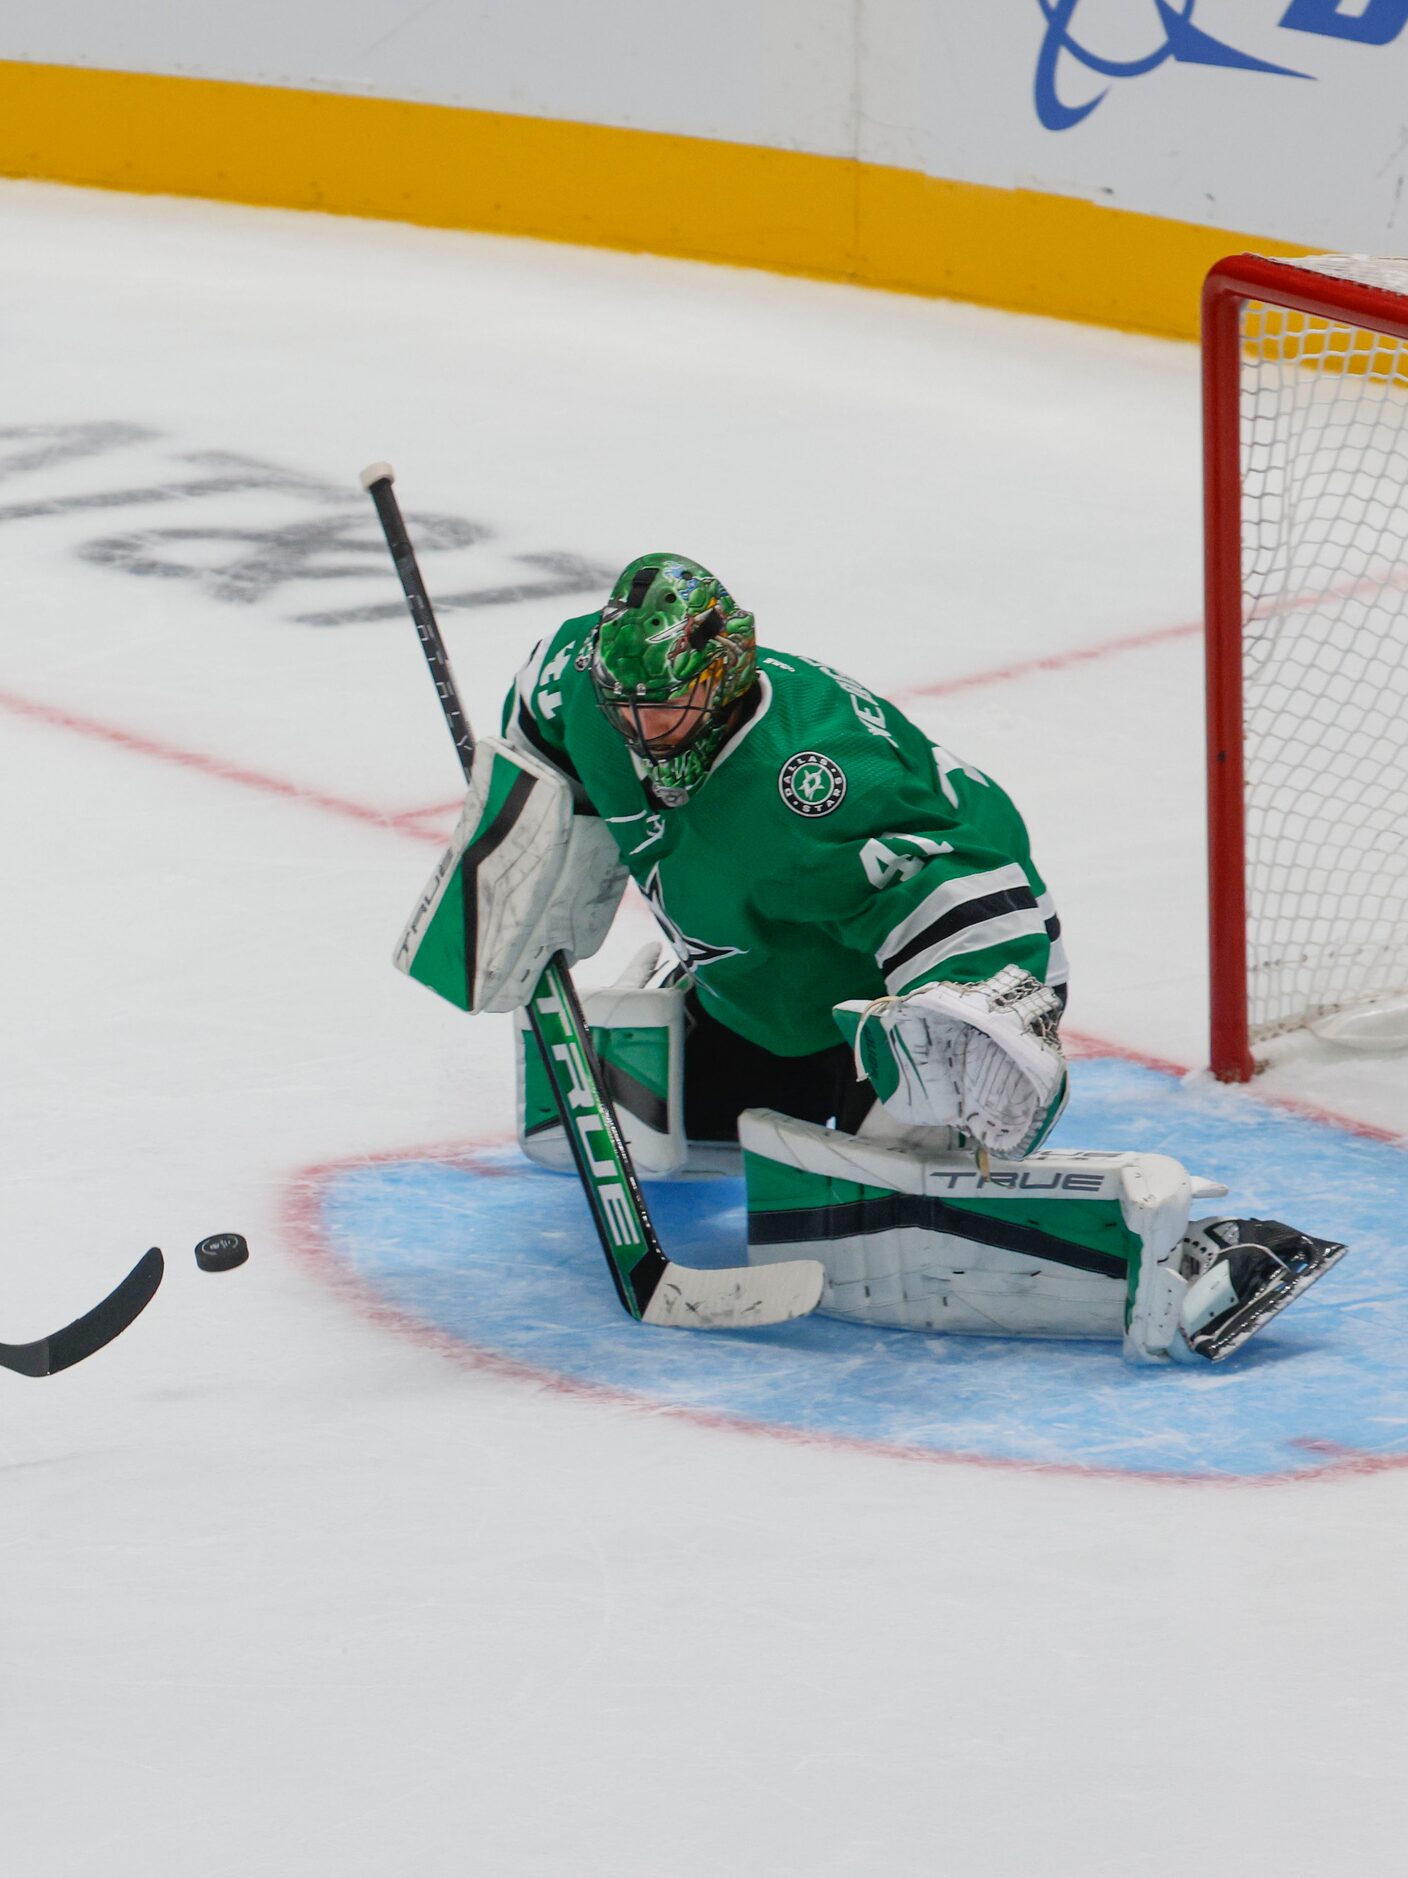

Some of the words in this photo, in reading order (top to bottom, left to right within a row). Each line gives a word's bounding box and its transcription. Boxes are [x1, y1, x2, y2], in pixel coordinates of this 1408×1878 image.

[782, 754, 829, 798] DALLAS
[801, 776, 843, 813] STARS
[536, 967, 641, 1247] TRUE
[929, 1171, 1105, 1192] TRUE
